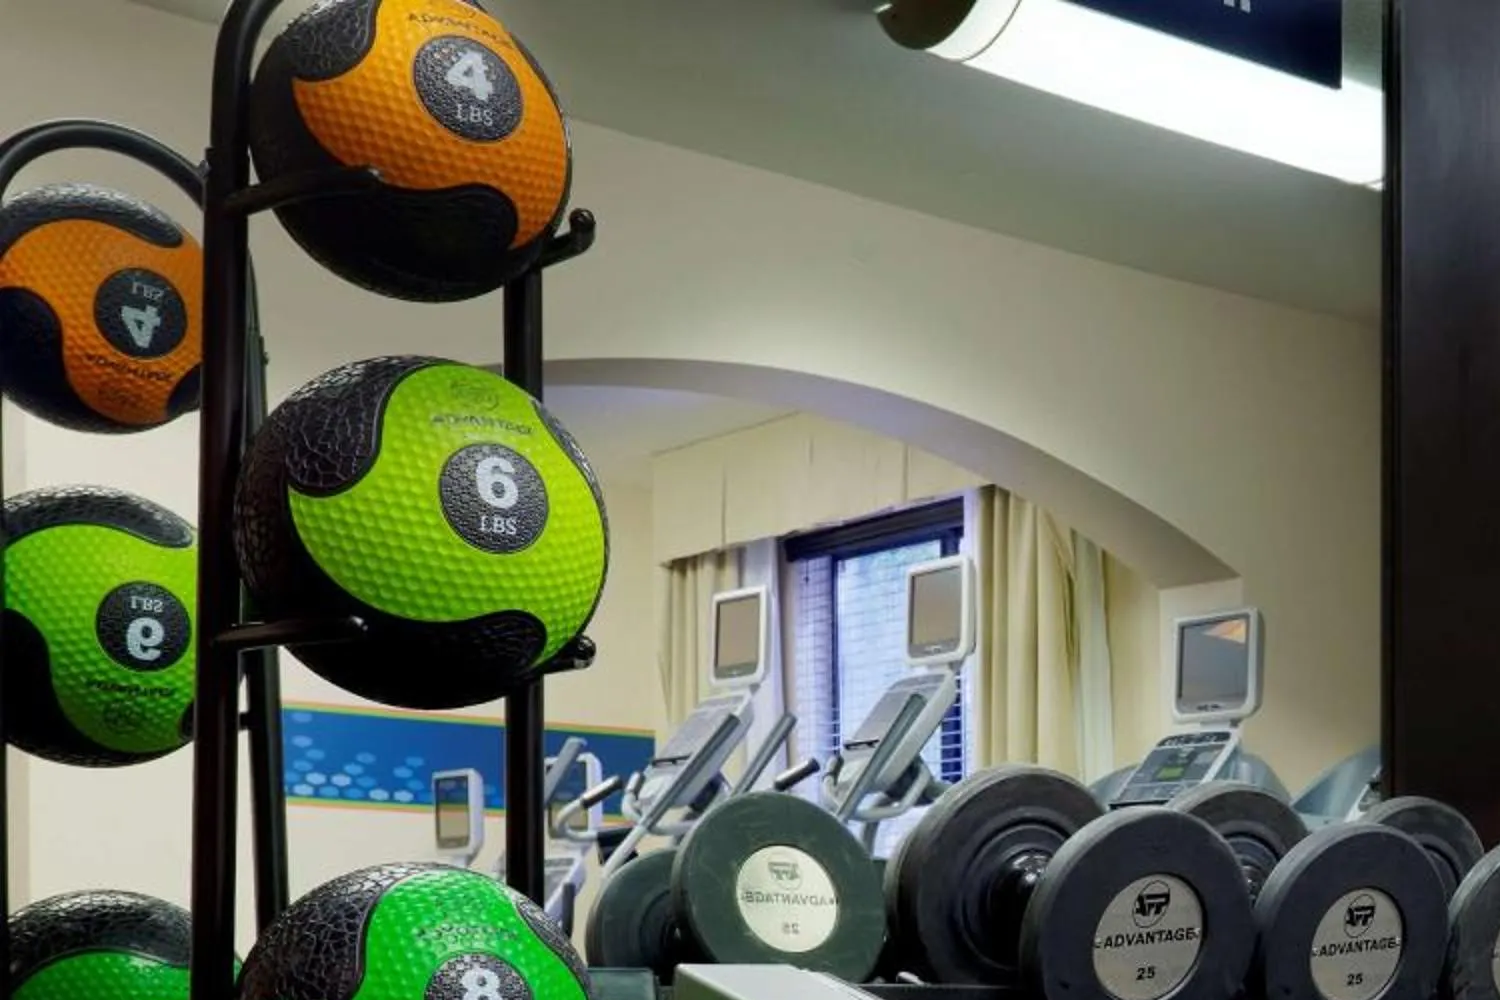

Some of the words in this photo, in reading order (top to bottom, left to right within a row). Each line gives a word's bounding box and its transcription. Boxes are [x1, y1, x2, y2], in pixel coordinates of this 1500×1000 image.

[445, 50, 494, 101] 4
[455, 103, 494, 127] LBS
[476, 456, 519, 510] 6
[479, 515, 517, 536] LBS
[1104, 928, 1195, 948] ADVANTAGE
[1320, 937, 1396, 957] ADVANTAGE
[1136, 966, 1156, 981] 25
[1347, 973, 1363, 986] 25
